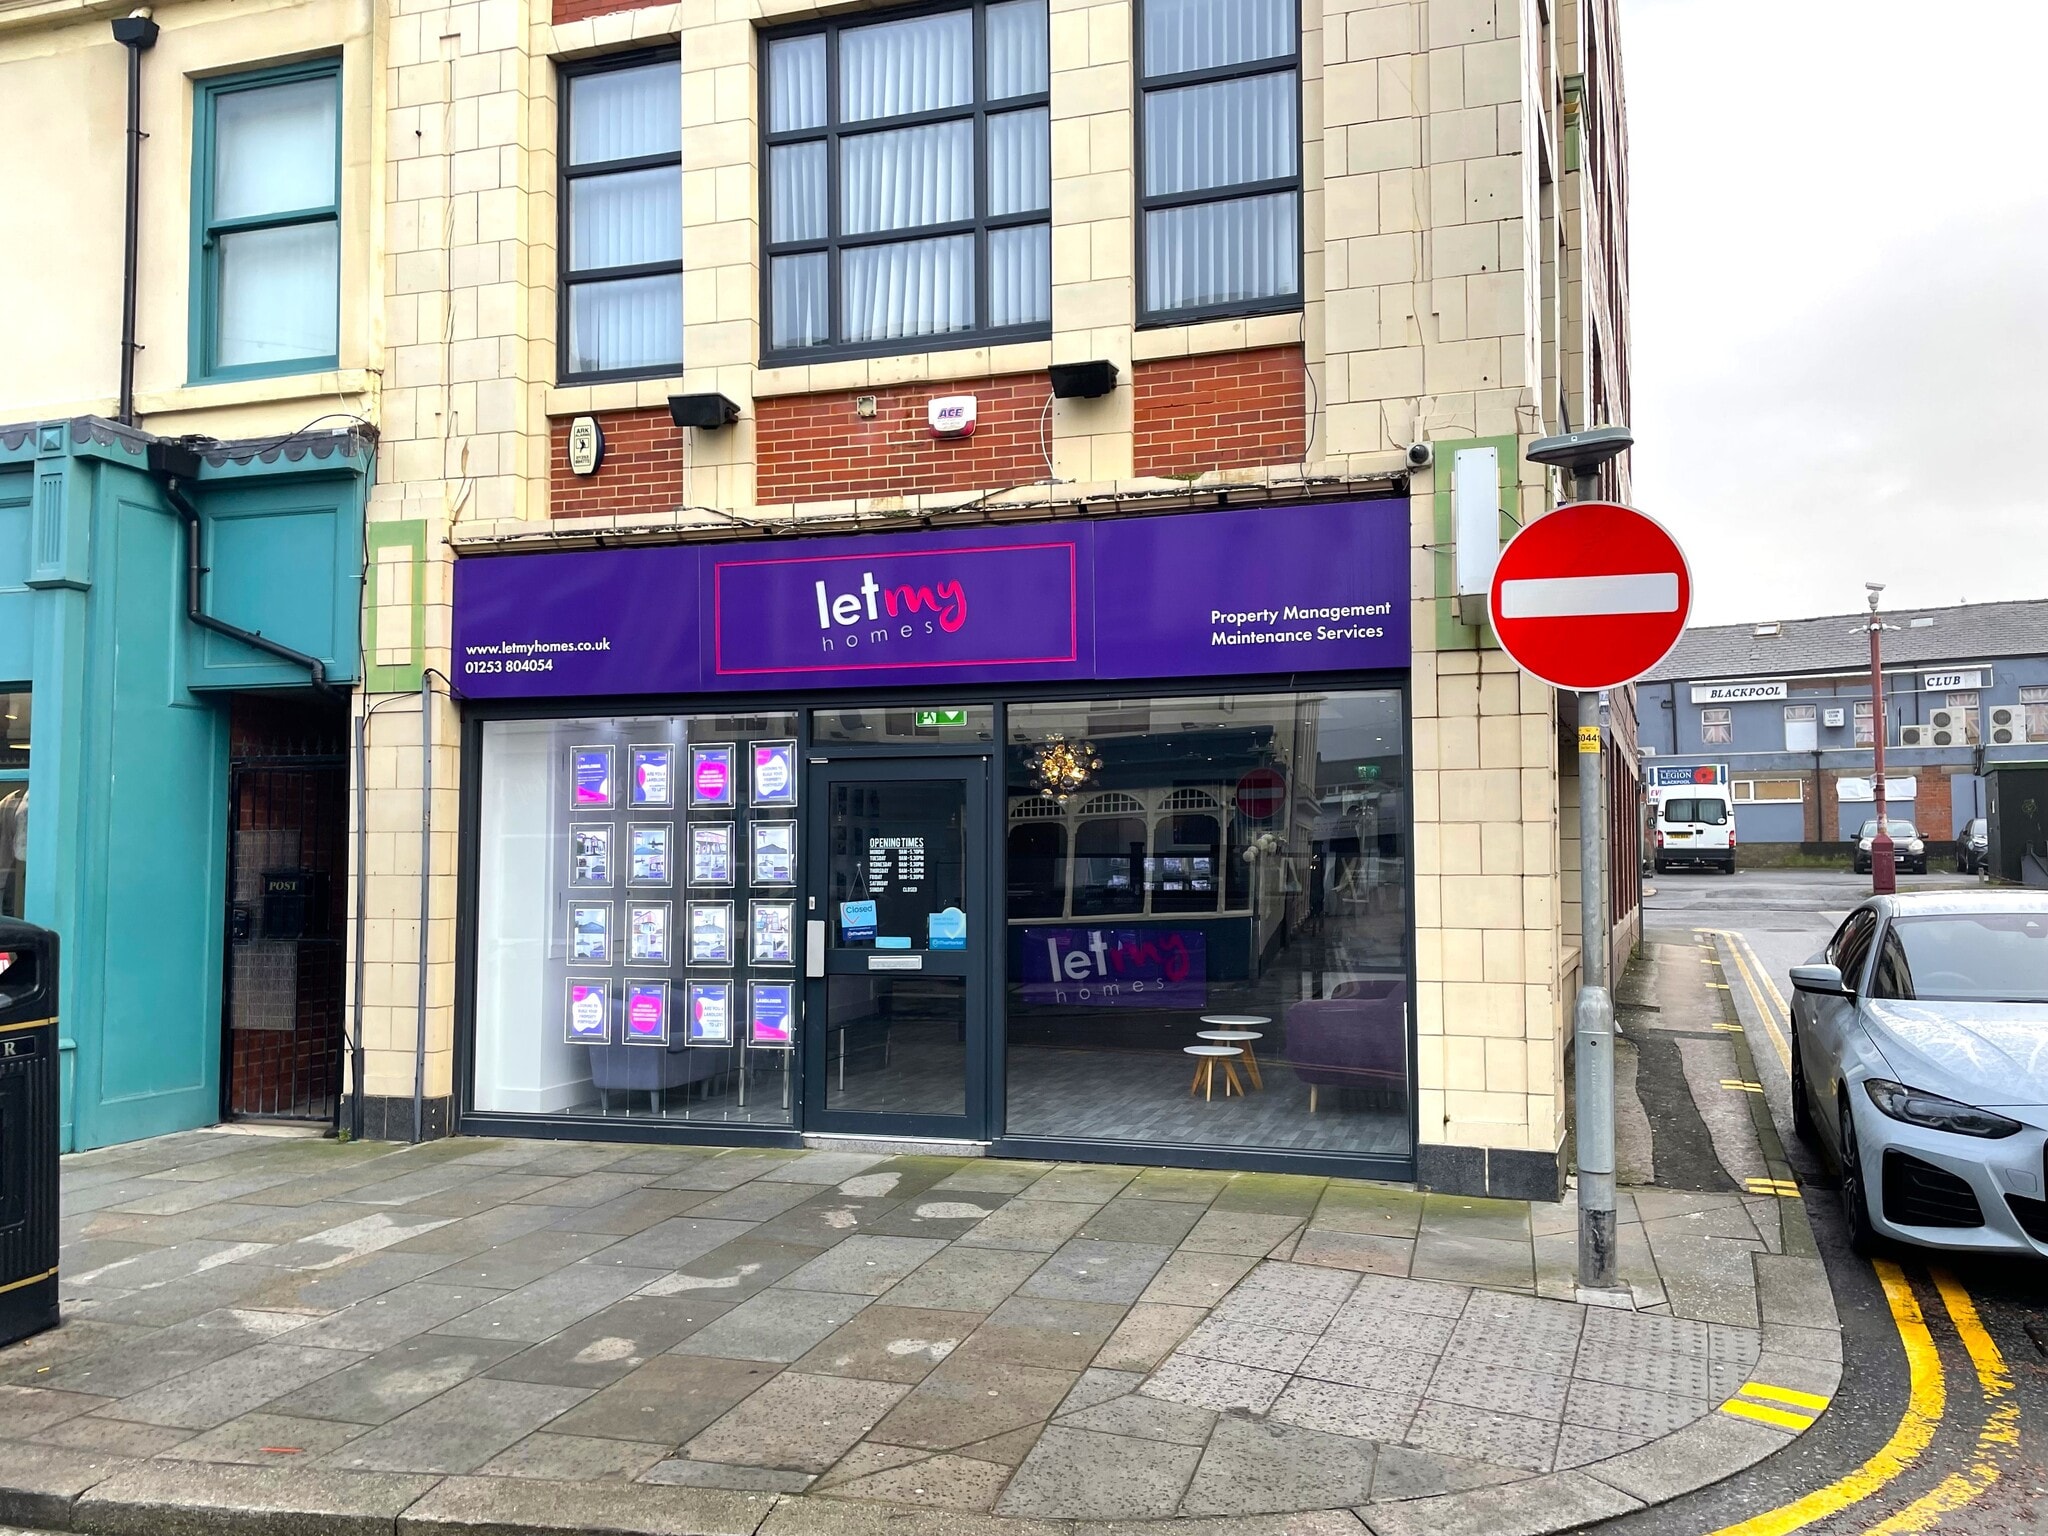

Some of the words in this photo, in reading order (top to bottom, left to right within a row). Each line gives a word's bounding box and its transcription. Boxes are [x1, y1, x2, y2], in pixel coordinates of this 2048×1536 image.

[938, 407, 964, 419] ACE
[1211, 609, 1279, 627] Property
[1283, 602, 1392, 622] Management
[822, 621, 934, 652] homes
[1211, 631, 1313, 646] Maintenance
[1317, 624, 1384, 641] Services
[465, 637, 611, 657] www.letmyhomes.co.uk
[465, 660, 502, 674] 01253
[505, 659, 554, 673] 804054
[1710, 686, 1781, 699] BLACKPOOL
[1926, 675, 1961, 687] CLUB
[1660, 772, 1692, 780] LEGION
[870, 838, 900, 848] OPENING
[901, 837, 924, 847] TIMES
[269, 881, 297, 890] POST
[845, 905, 873, 914] Closed
[1055, 977, 1165, 1004] homes
